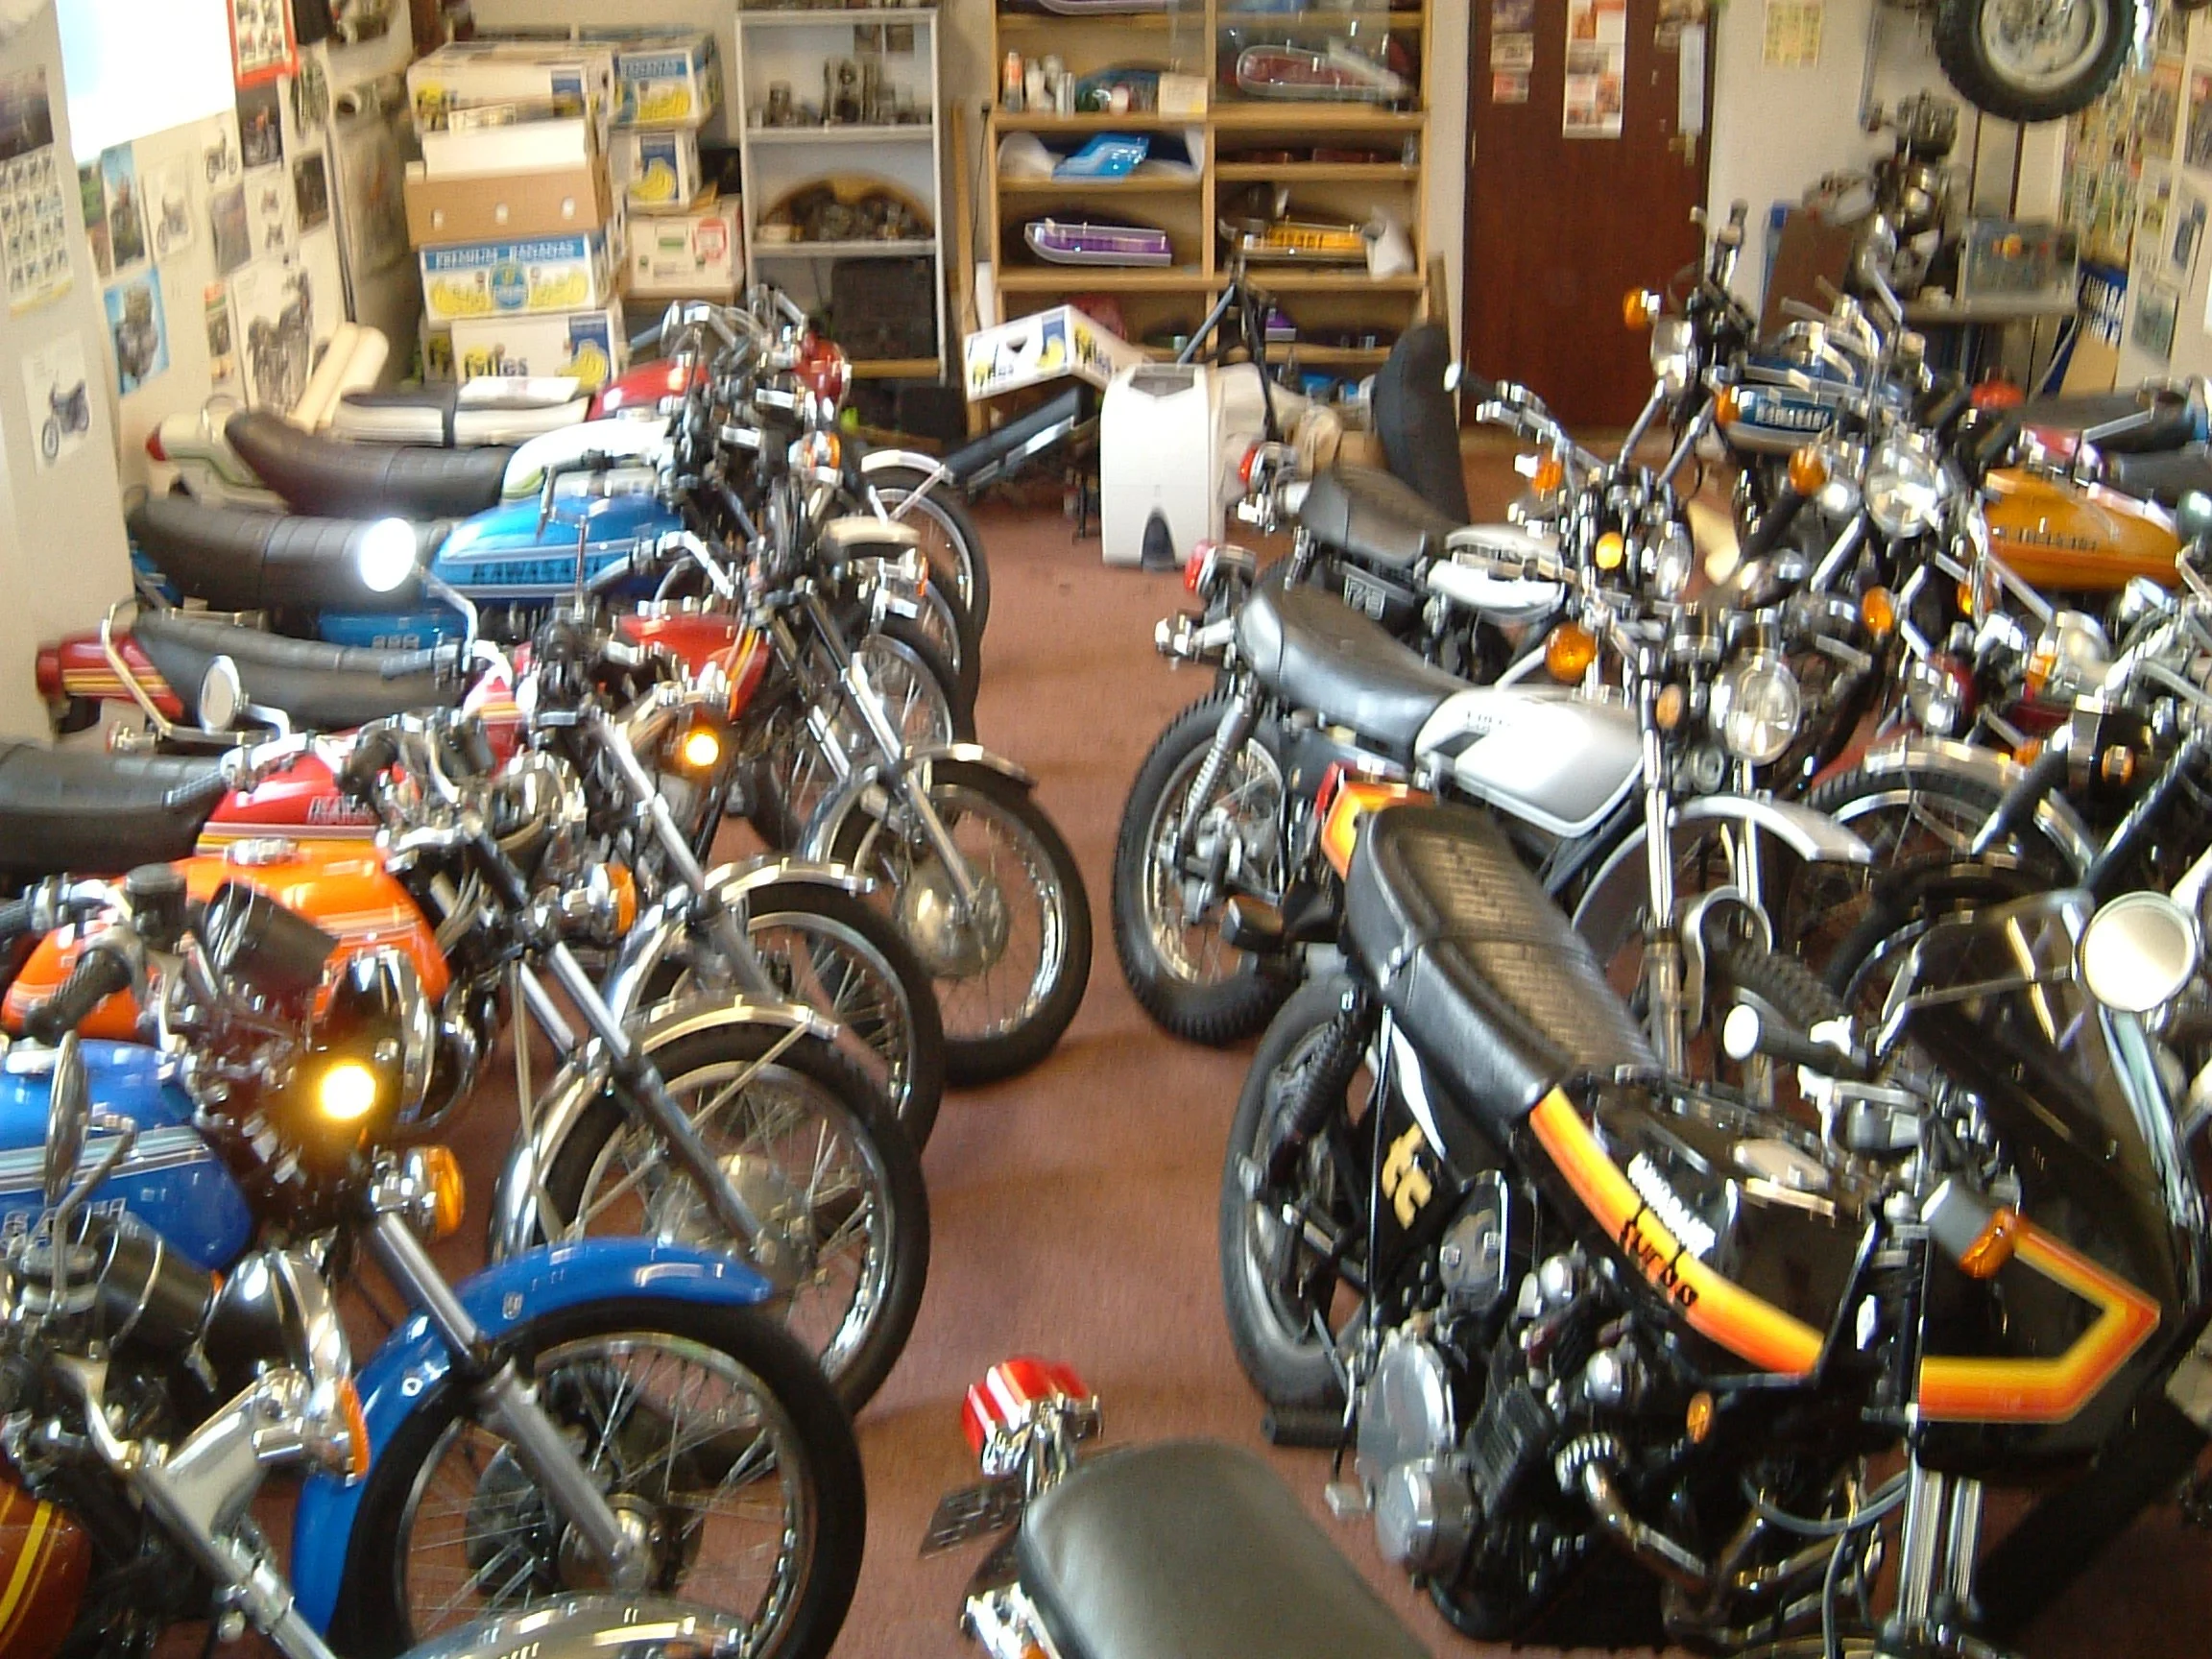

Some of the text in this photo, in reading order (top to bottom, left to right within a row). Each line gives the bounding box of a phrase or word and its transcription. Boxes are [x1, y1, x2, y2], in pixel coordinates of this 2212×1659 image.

[435, 241, 576, 270] PREMIUM BANANAS
[1618, 1196, 1699, 1308] turbo
